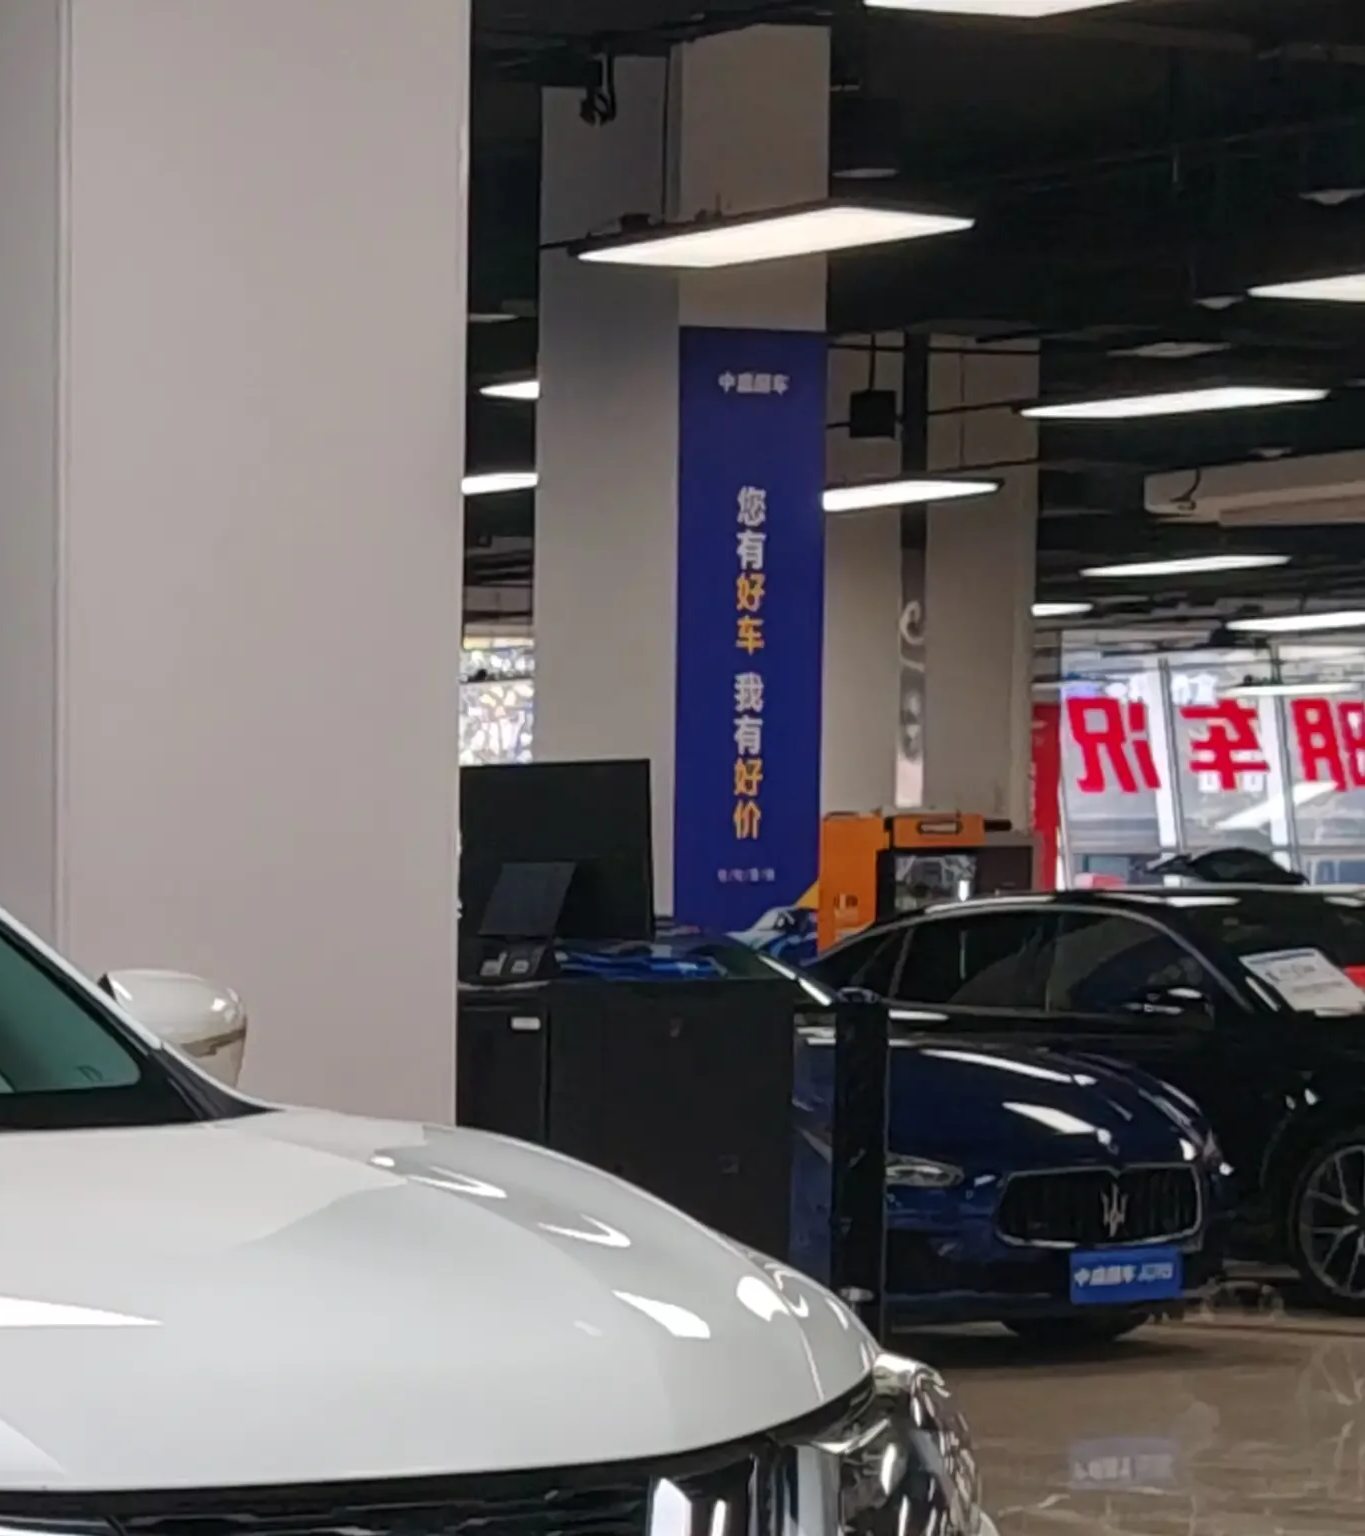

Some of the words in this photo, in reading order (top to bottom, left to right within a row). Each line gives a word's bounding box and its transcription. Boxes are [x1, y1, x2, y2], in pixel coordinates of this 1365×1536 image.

[735, 485, 767, 656] 您有好车
[732, 671, 764, 840] 我有好价
